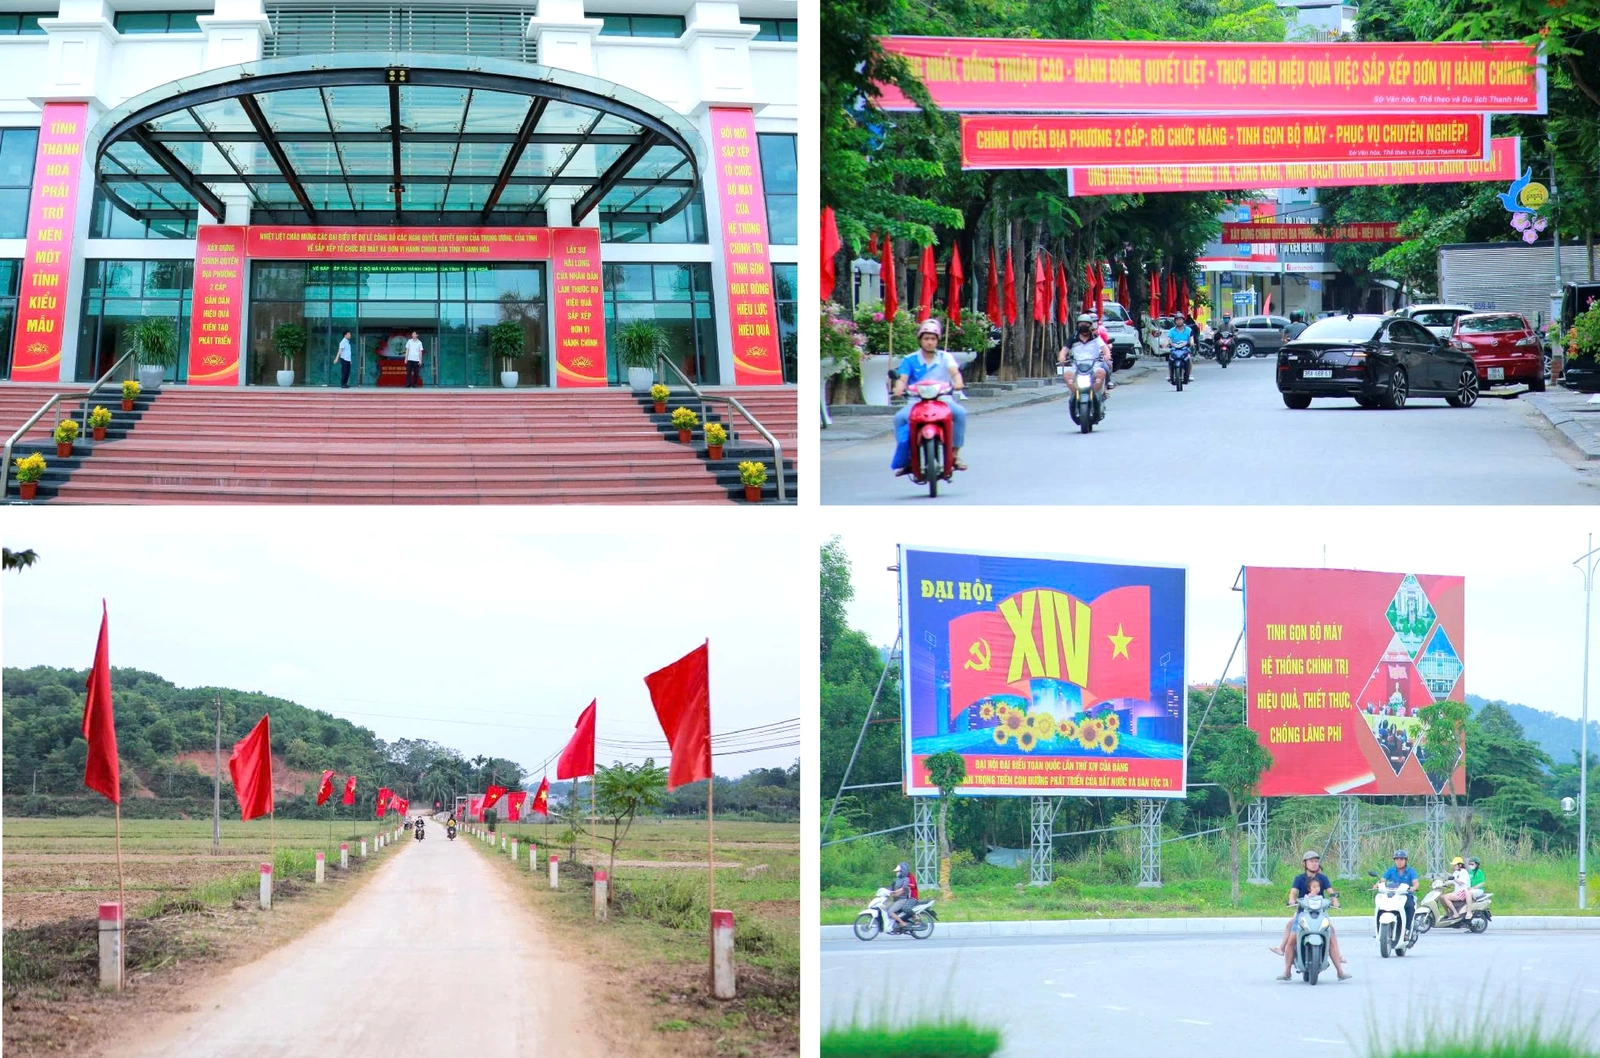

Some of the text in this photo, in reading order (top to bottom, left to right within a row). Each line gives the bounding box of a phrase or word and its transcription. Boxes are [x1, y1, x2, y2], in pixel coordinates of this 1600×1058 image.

[963, 48, 995, 82] ĐỒNG
[999, 52, 1037, 87] THUẬN
[1041, 58, 1064, 82] CAO
[1074, 51, 1106, 84] HÀNH
[1110, 52, 1141, 89] ĐỘNG
[1145, 51, 1180, 87] QUYẾT
[1183, 54, 1206, 91] LIỆT
[1216, 58, 1246, 90] THỰC
[1249, 54, 1276, 90] HIỆN
[1279, 54, 1304, 90] HIỆU
[1308, 52, 1331, 88] QUẢ
[1334, 56, 1358, 90] VIỆC
[1362, 52, 1384, 84] SẮP
[1388, 53, 1410, 84] XẾP
[1413, 58, 1437, 84] ĐƠN
[1440, 61, 1452, 90] VỊ
[1454, 55, 1485, 85] HÀNH
[50, 123, 77, 135] TỈNH
[977, 120, 1468, 152] CHÍNH QUYỀN ĐỊA PHƯƠNG 2 CẤP: RÕ CHỨC NĂNG TINH GỌN BỘ MÁY PHỤC VỤ CHUYÊN NGHIỆP!
[43, 144, 80, 155] THANH
[42, 182, 69, 198] PHẢI
[42, 206, 65, 220] TRỞ
[38, 228, 63, 241] NÊN
[35, 251, 61, 265] MỘT
[32, 271, 59, 287] TỈNH
[29, 292, 56, 310] KIỂU
[26, 316, 54, 333] MẪU
[921, 578, 993, 605] ĐẠI HỘI
[998, 590, 1092, 689] XIV
[1266, 621, 1342, 644] TINH GỌN BỘ MÁY
[1262, 652, 1349, 678] HỆ THỐNG CHÍNH TRỊ
[1258, 688, 1352, 712] HIỆU QUẢ, THIẾT THỰC,
[1270, 722, 1342, 744] CHỐNG LÃNG PHÍ
[1089, 762, 1098, 771] XIV
